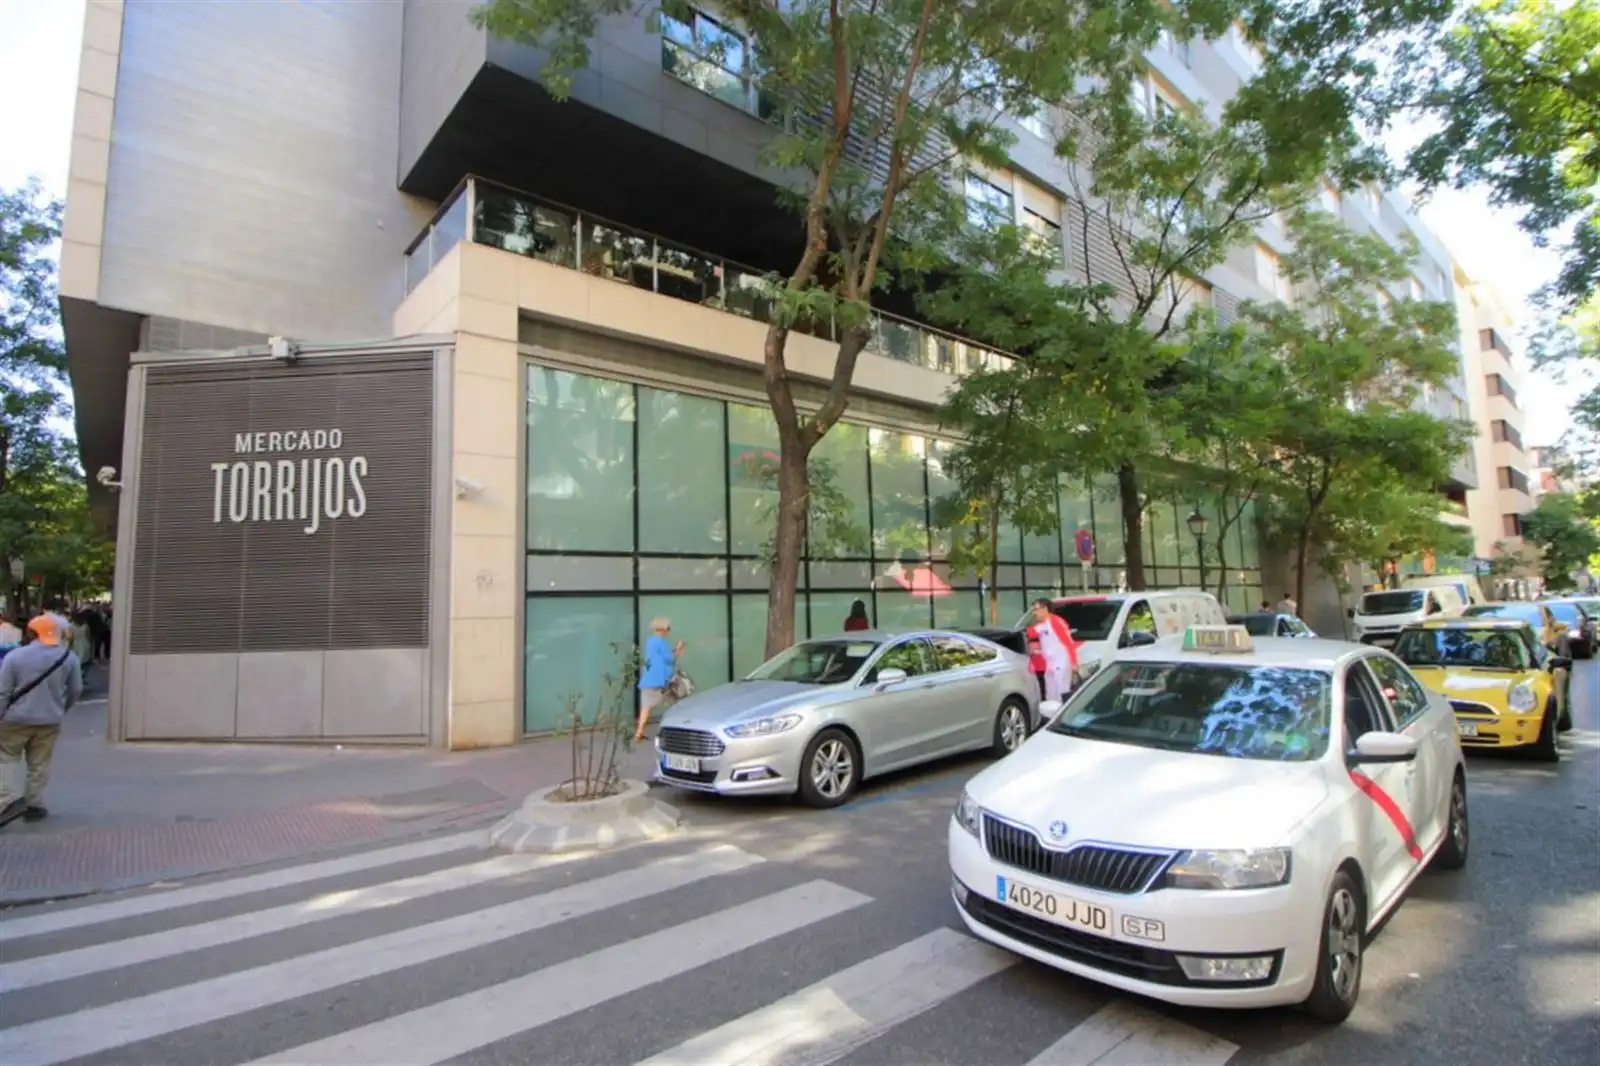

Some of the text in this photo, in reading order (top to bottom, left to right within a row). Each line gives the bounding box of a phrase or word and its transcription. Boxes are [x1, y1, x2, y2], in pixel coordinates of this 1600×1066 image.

[235, 428, 343, 453] MERCADO
[211, 456, 368, 535] TORRIJOS
[1009, 884, 1106, 930] 4020 JJD
[1126, 919, 1159, 937] SP
